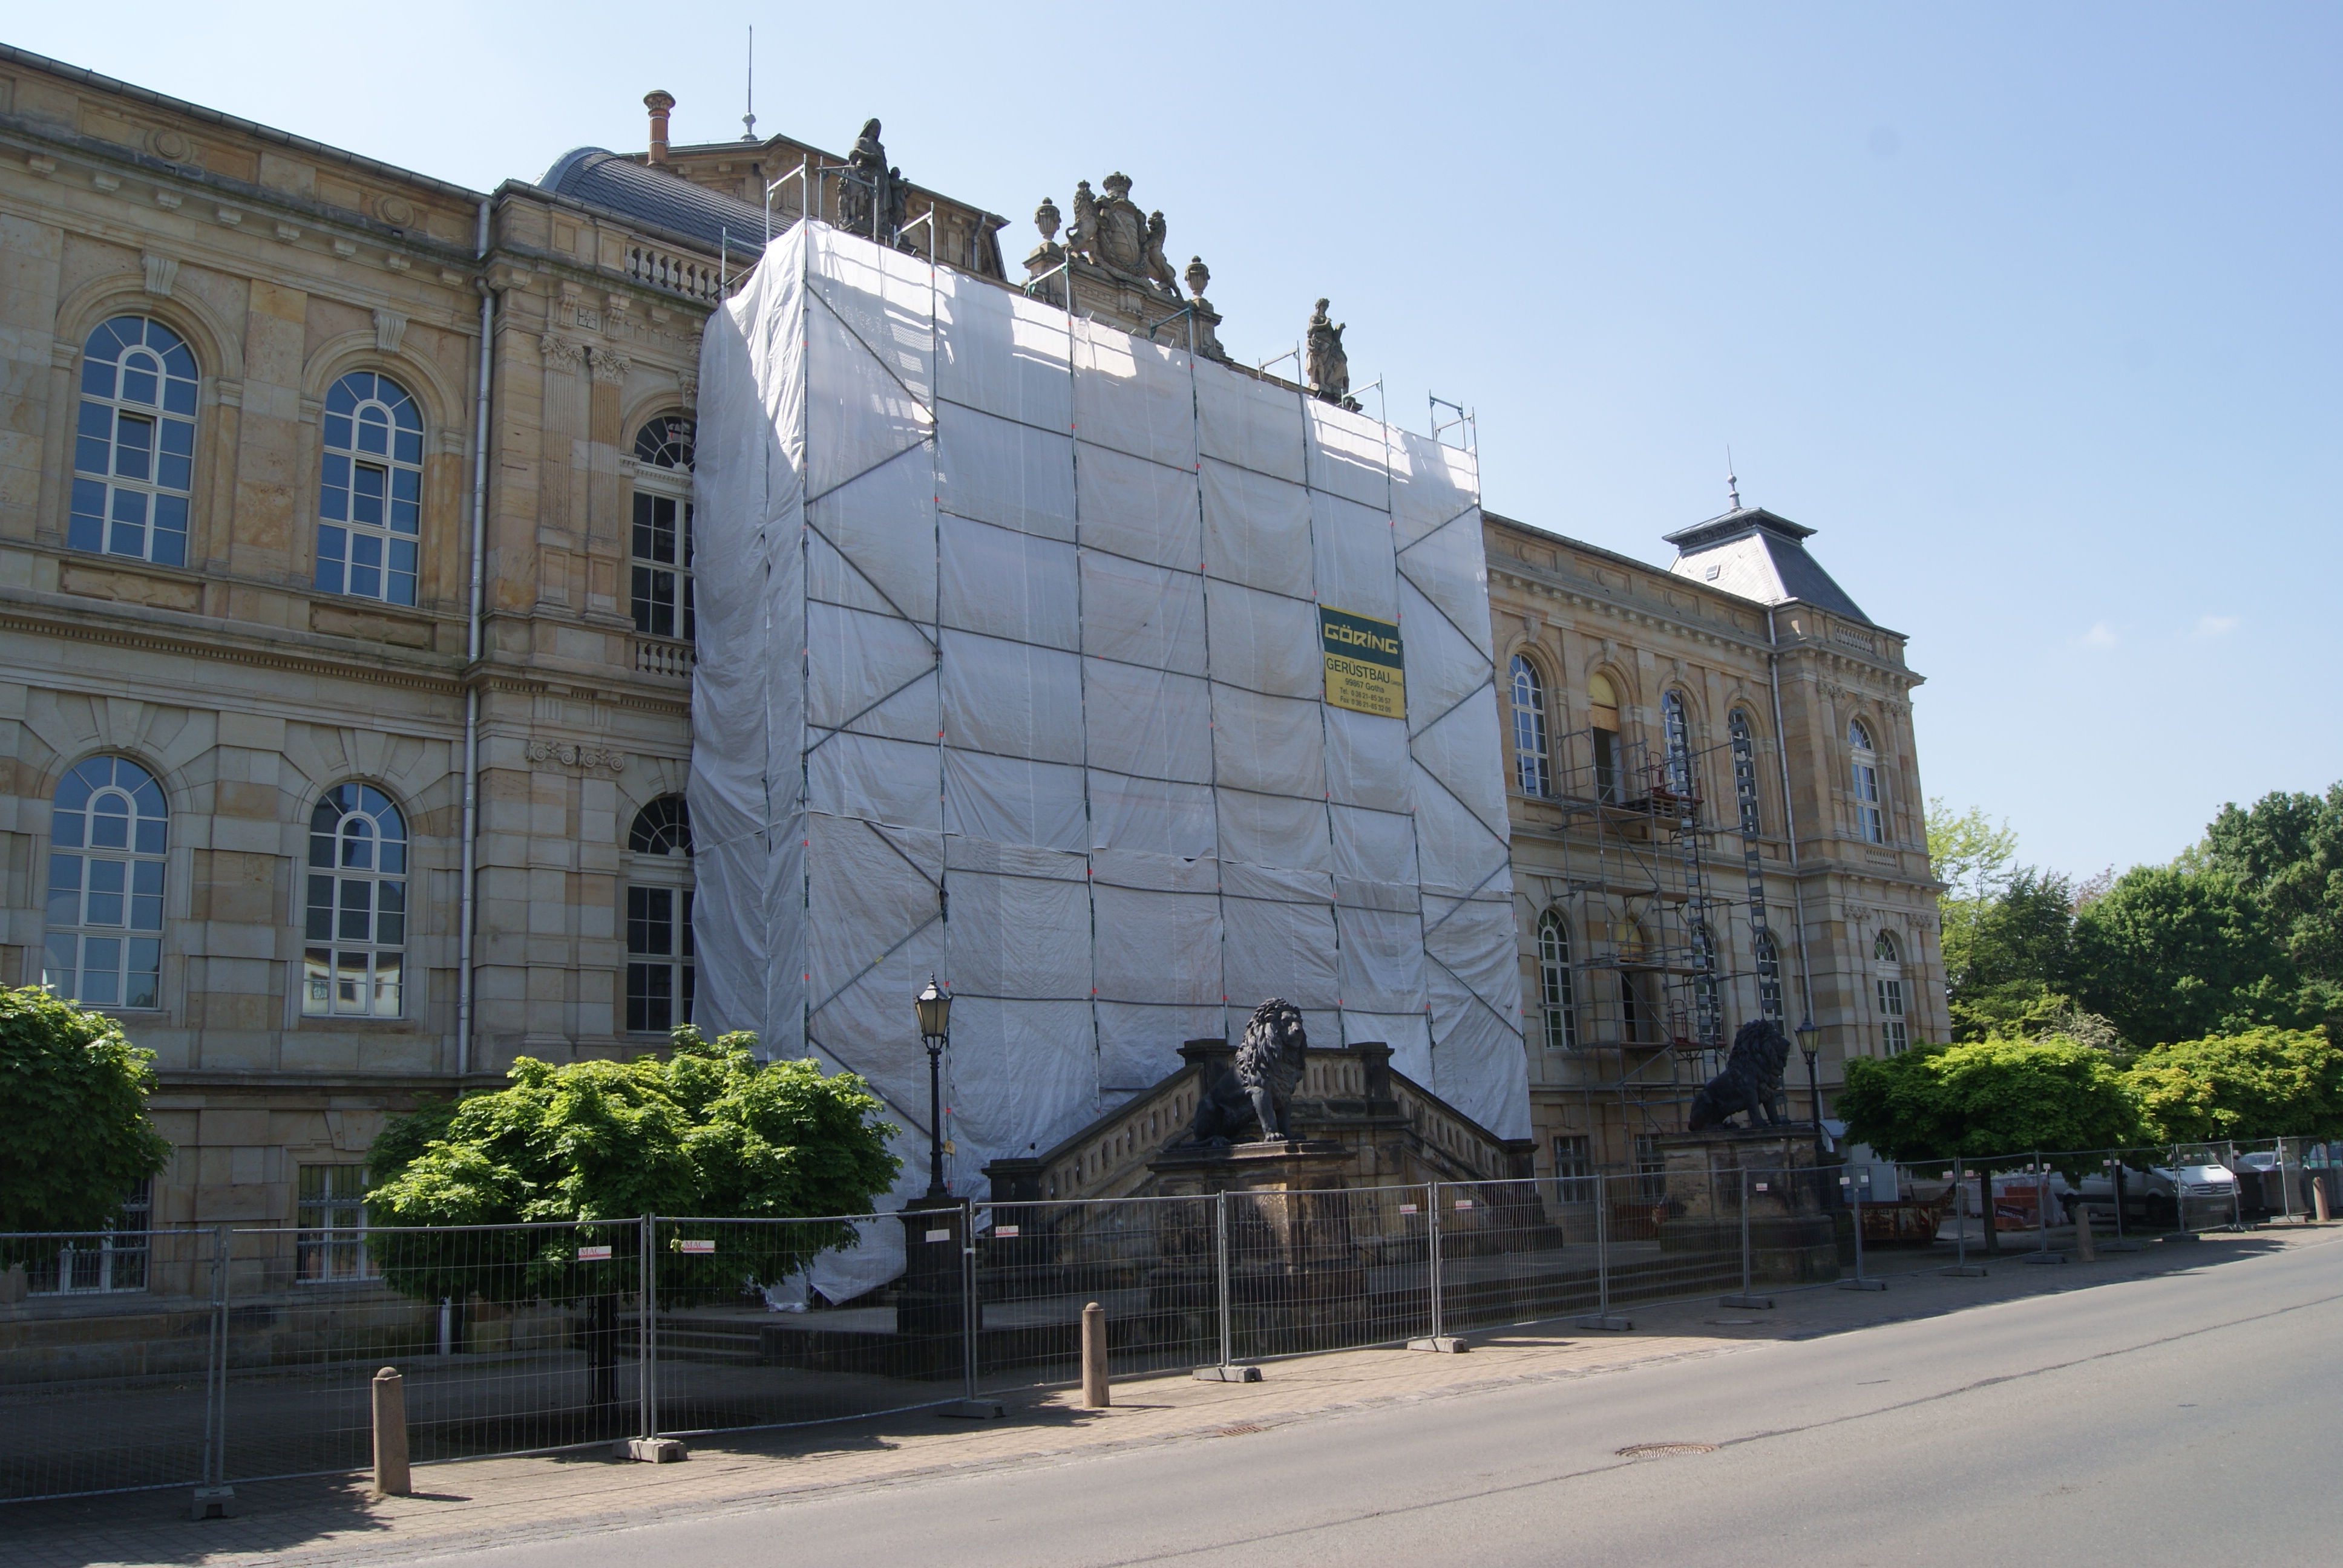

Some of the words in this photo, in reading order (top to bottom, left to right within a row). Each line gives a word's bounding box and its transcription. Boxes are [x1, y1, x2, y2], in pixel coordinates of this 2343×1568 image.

[1325, 623, 1398, 655] GÖRING
[1326, 658, 1390, 684] GERÜSTBAU
[1340, 687, 1349, 695] Tel.
[1345, 678, 1364, 688] 99867
[1365, 682, 1384, 693] Gotha
[580, 1247, 600, 1255] MAC
